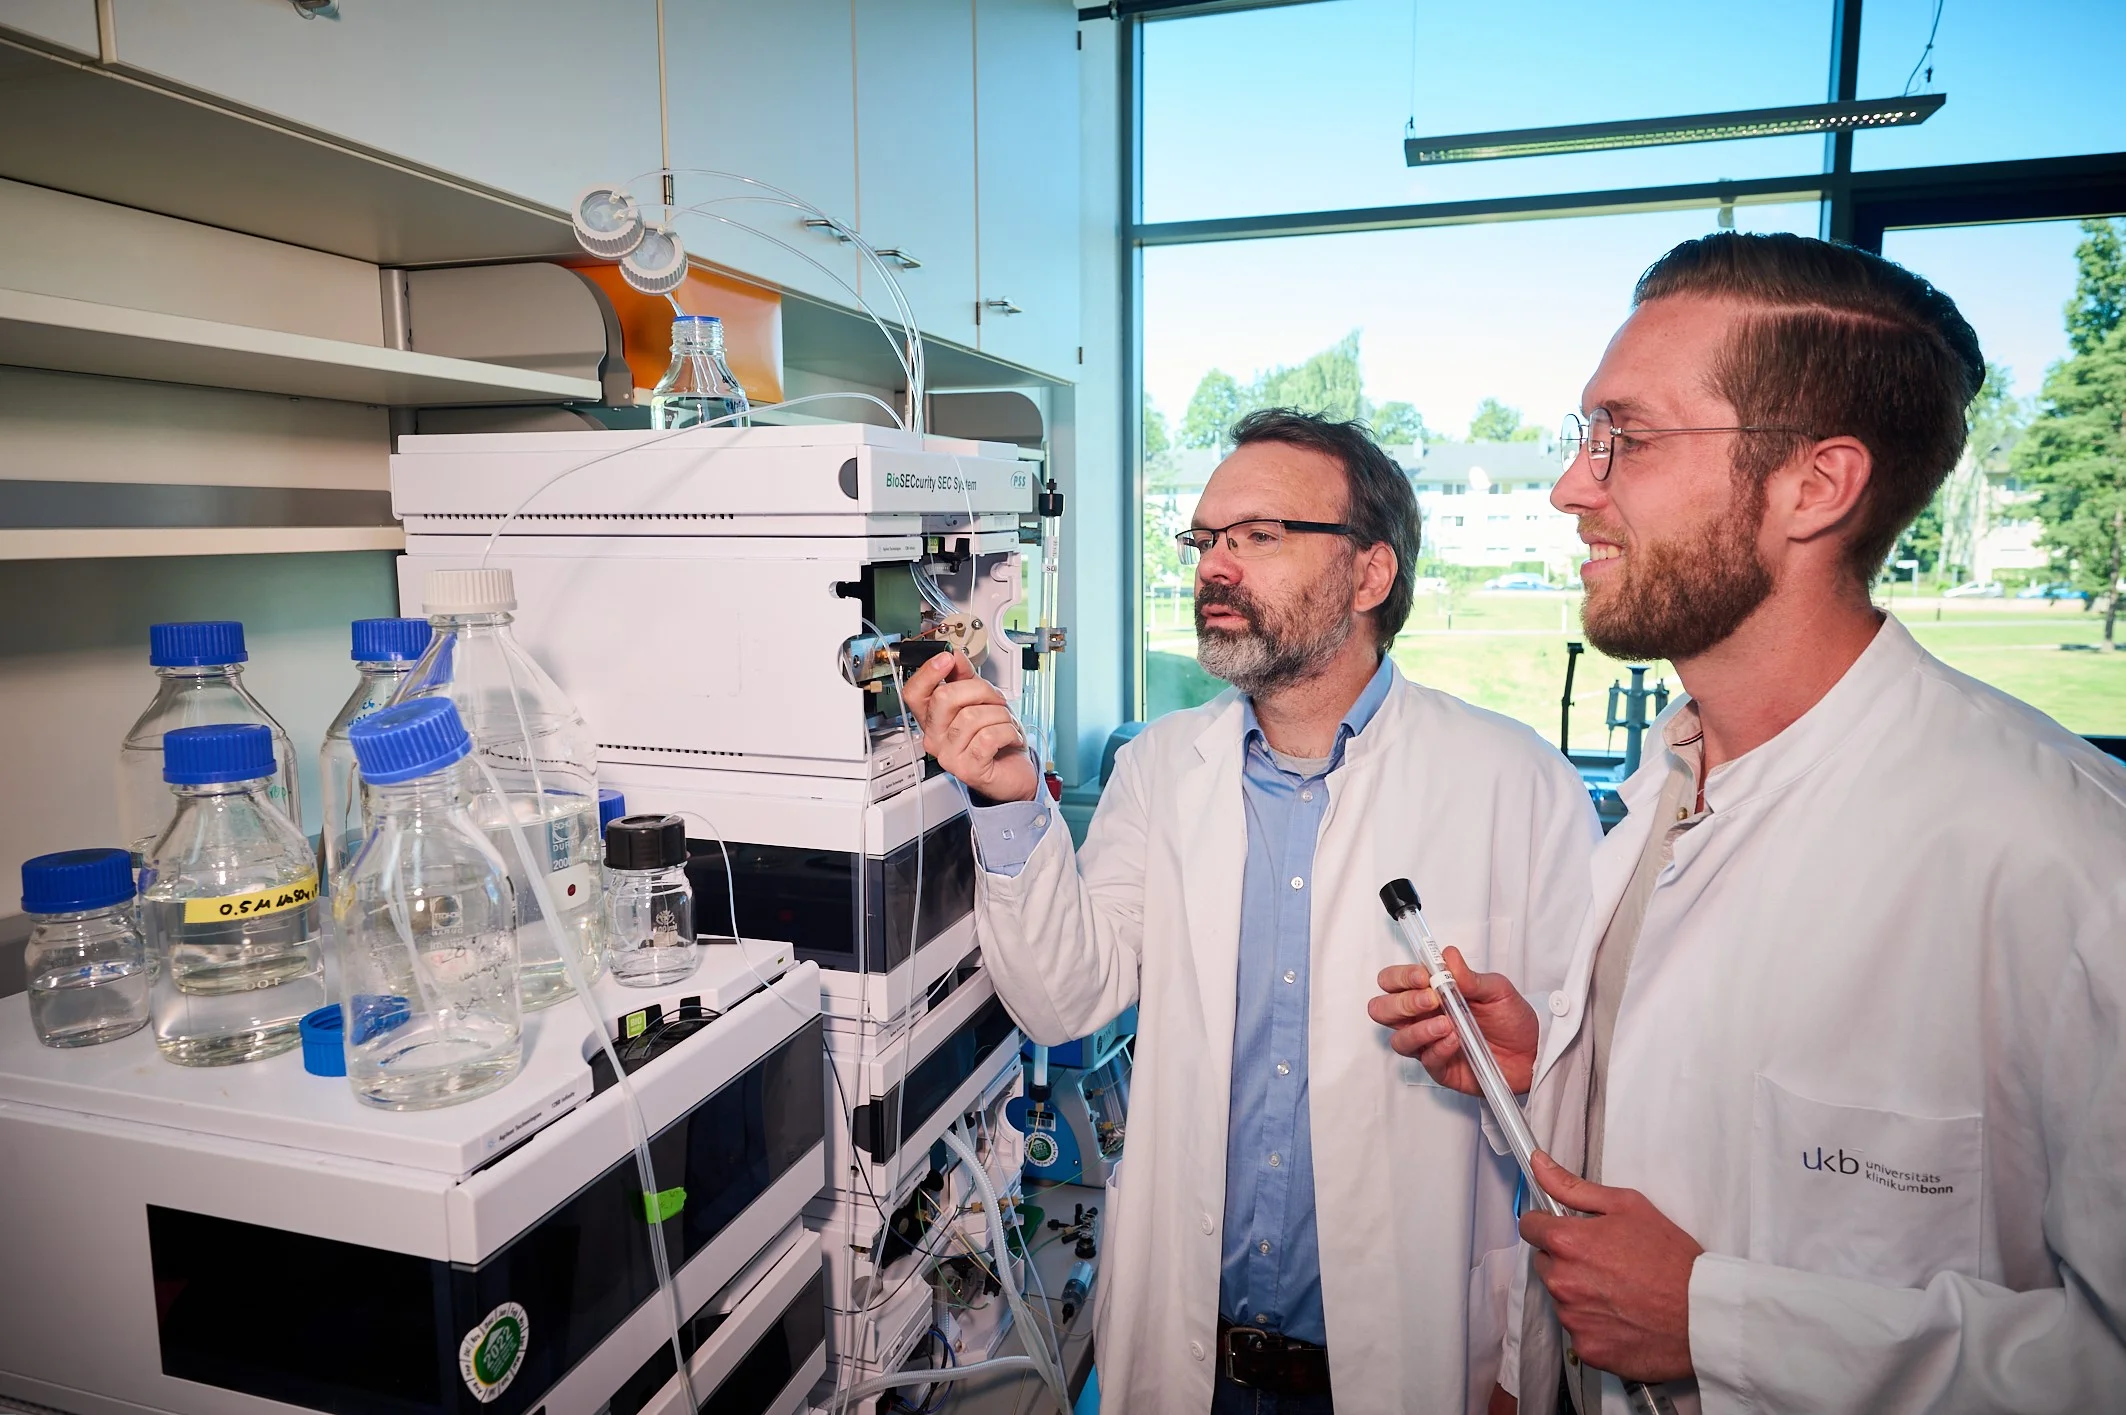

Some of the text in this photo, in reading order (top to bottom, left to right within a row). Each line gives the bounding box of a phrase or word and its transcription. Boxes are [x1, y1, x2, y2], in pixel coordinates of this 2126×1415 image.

[886, 472, 936, 493] BioSECcurity
[937, 476, 952, 490] SEC
[1013, 475, 1026, 487] PSS
[219, 900, 252, 916] 0.5
[1803, 1146, 1941, 1183] ukb universitäts
[1865, 1170, 1954, 1194] klinikumbonn
[483, 1325, 512, 1369] 2022
